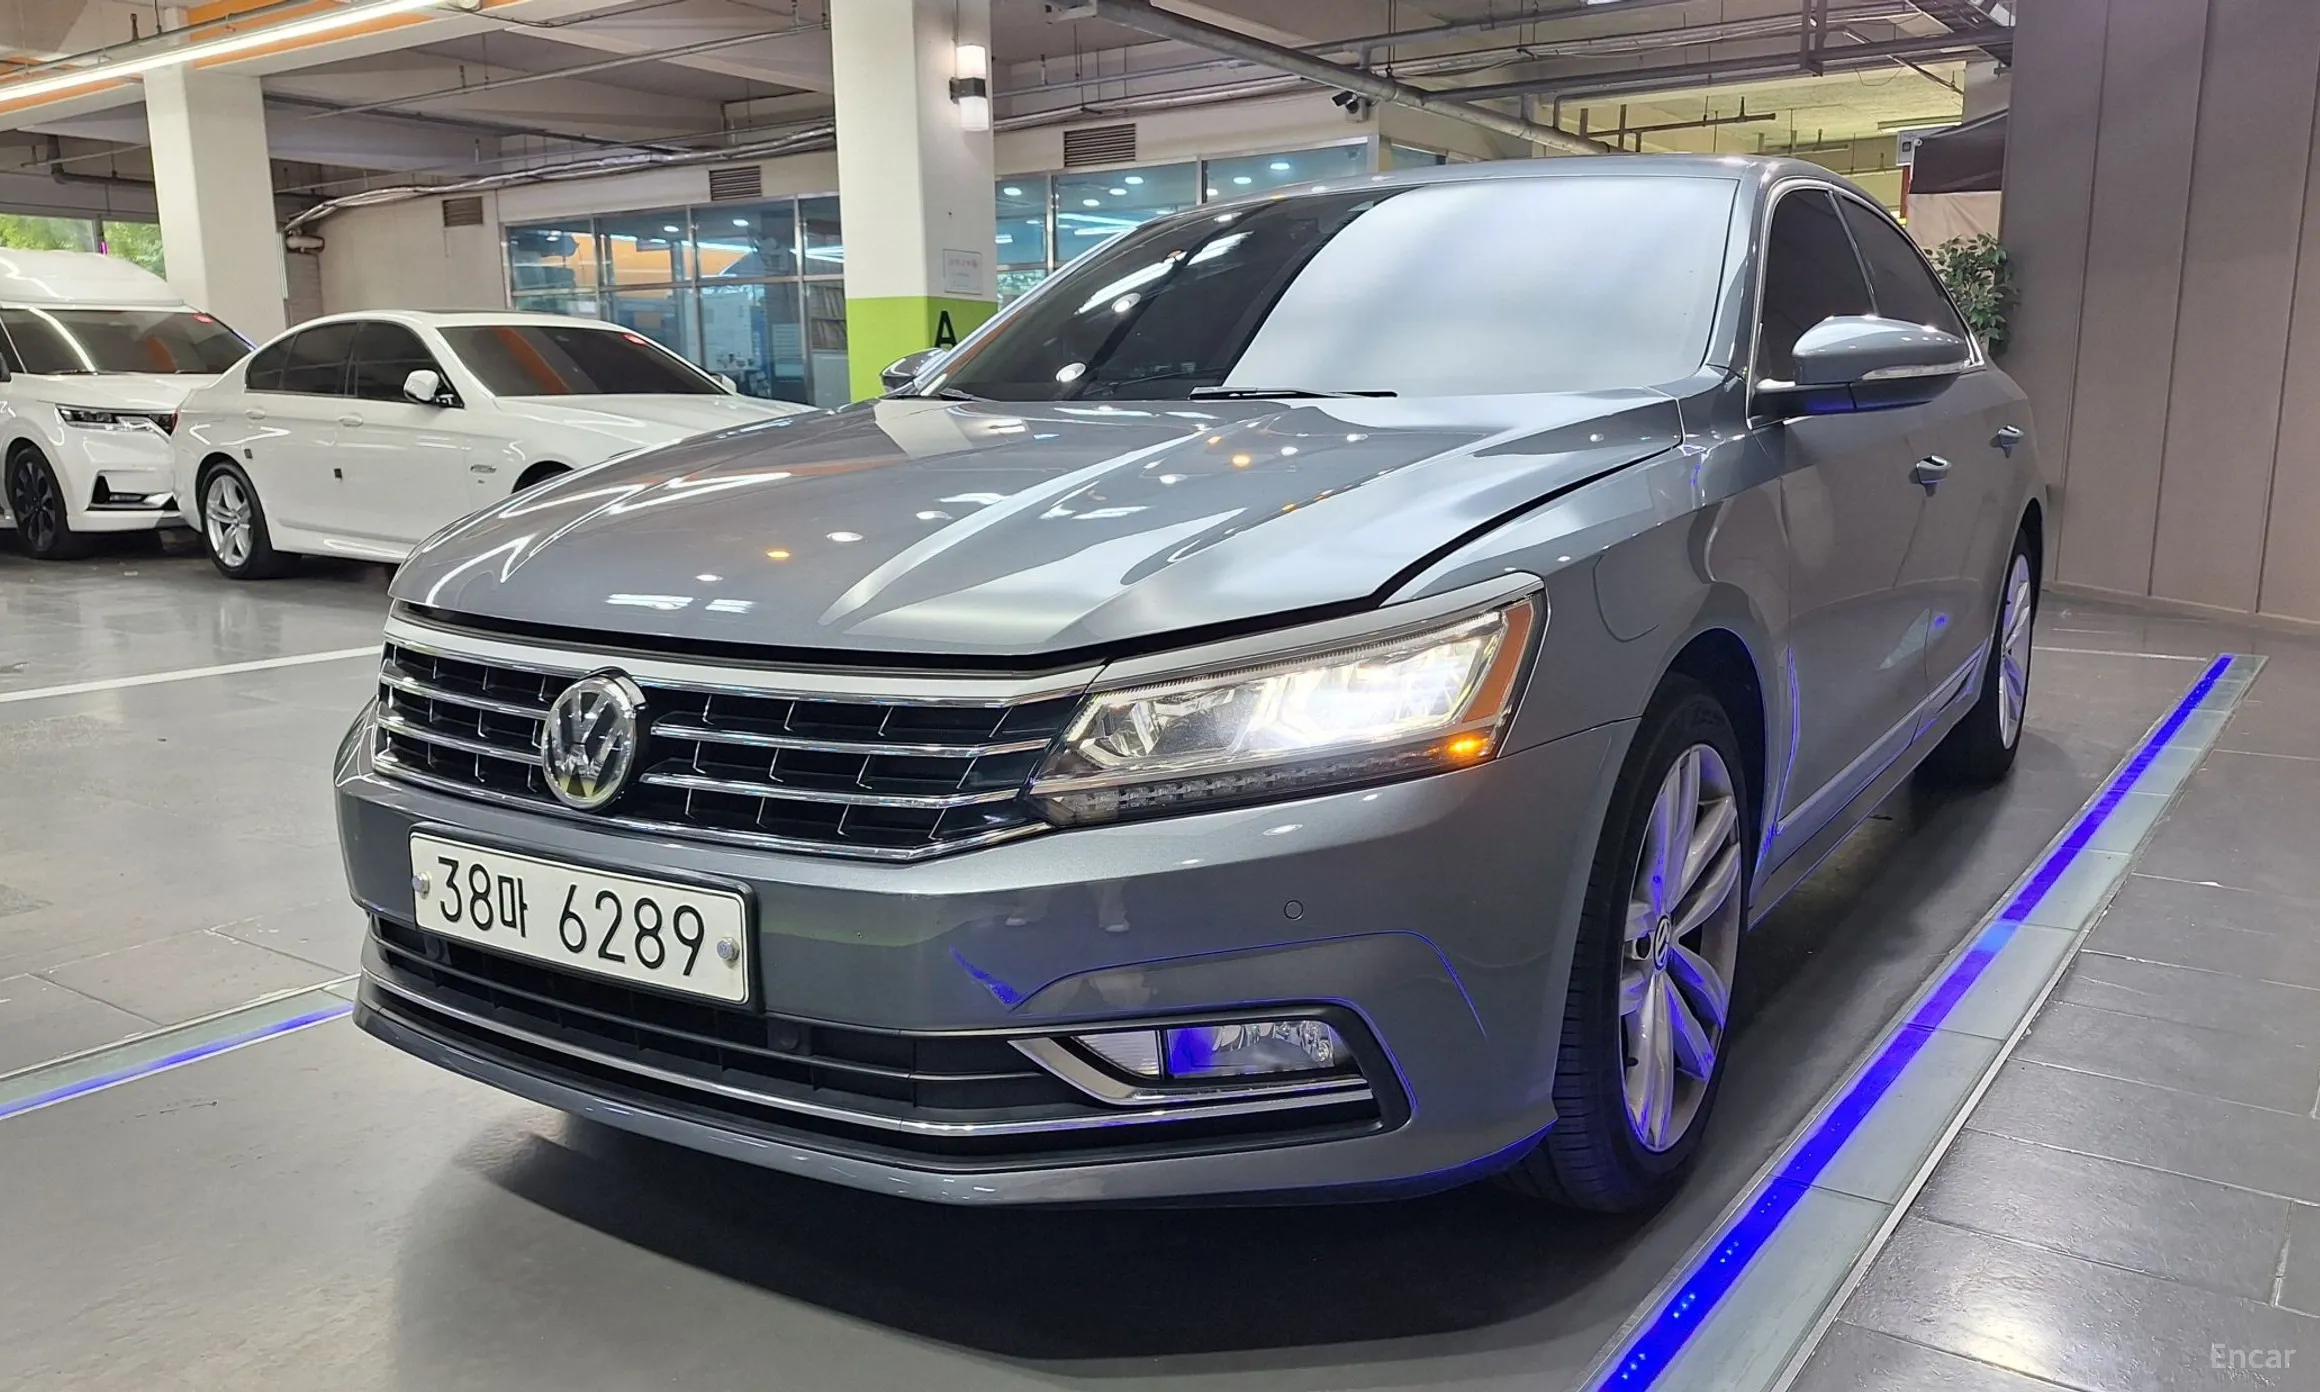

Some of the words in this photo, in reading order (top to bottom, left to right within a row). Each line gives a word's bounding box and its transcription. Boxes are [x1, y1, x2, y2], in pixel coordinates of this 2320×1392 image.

[934, 310, 958, 348] A
[437, 856, 528, 938] 38마
[559, 884, 705, 976] 6289
